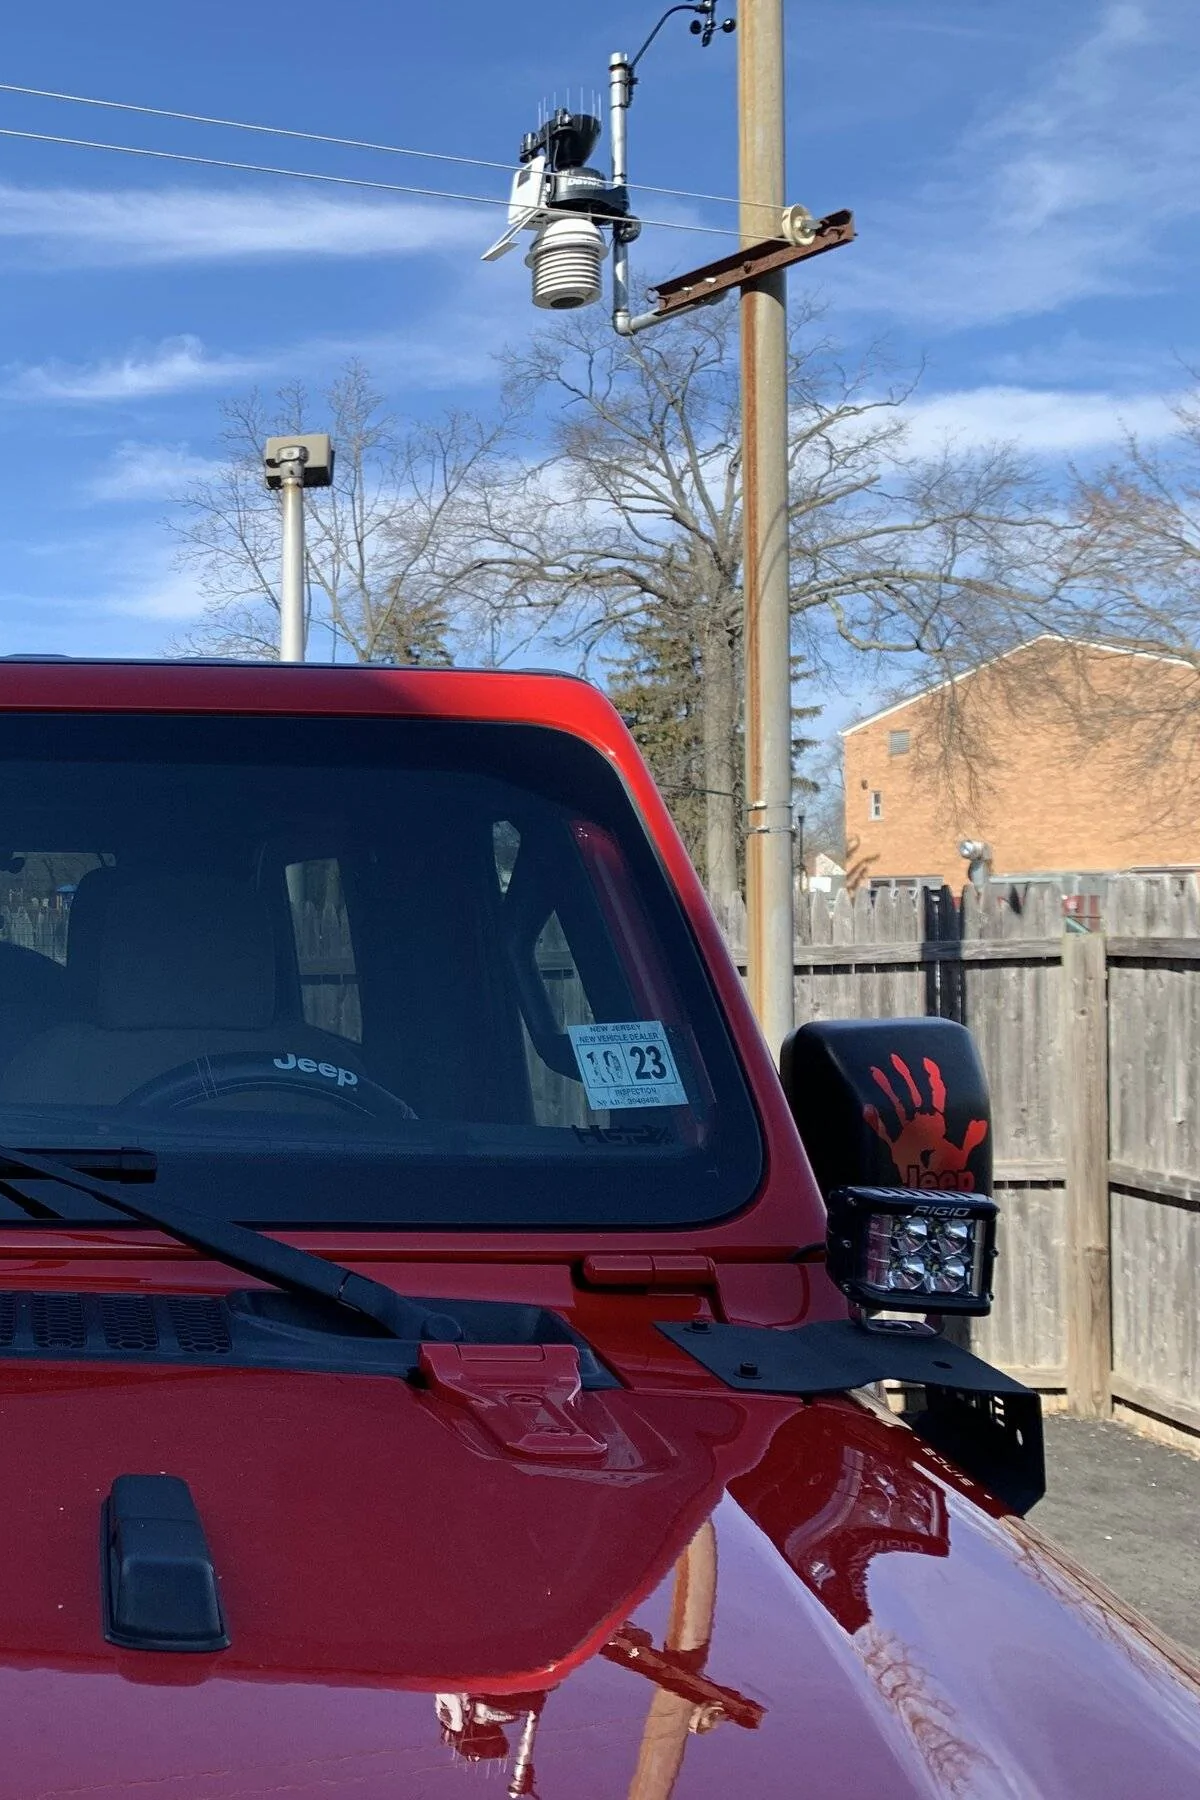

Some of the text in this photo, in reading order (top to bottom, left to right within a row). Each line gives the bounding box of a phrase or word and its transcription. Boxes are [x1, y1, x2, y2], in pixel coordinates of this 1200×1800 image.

[590, 1024, 641, 1033] NEW JERSEY
[579, 1032, 659, 1043] NEW VEHICLE DEALER
[629, 1045, 667, 1080] 23
[273, 1053, 359, 1087] Jeep
[615, 1087, 656, 1095] INSPECTION
[913, 1205, 971, 1217] RIGID
